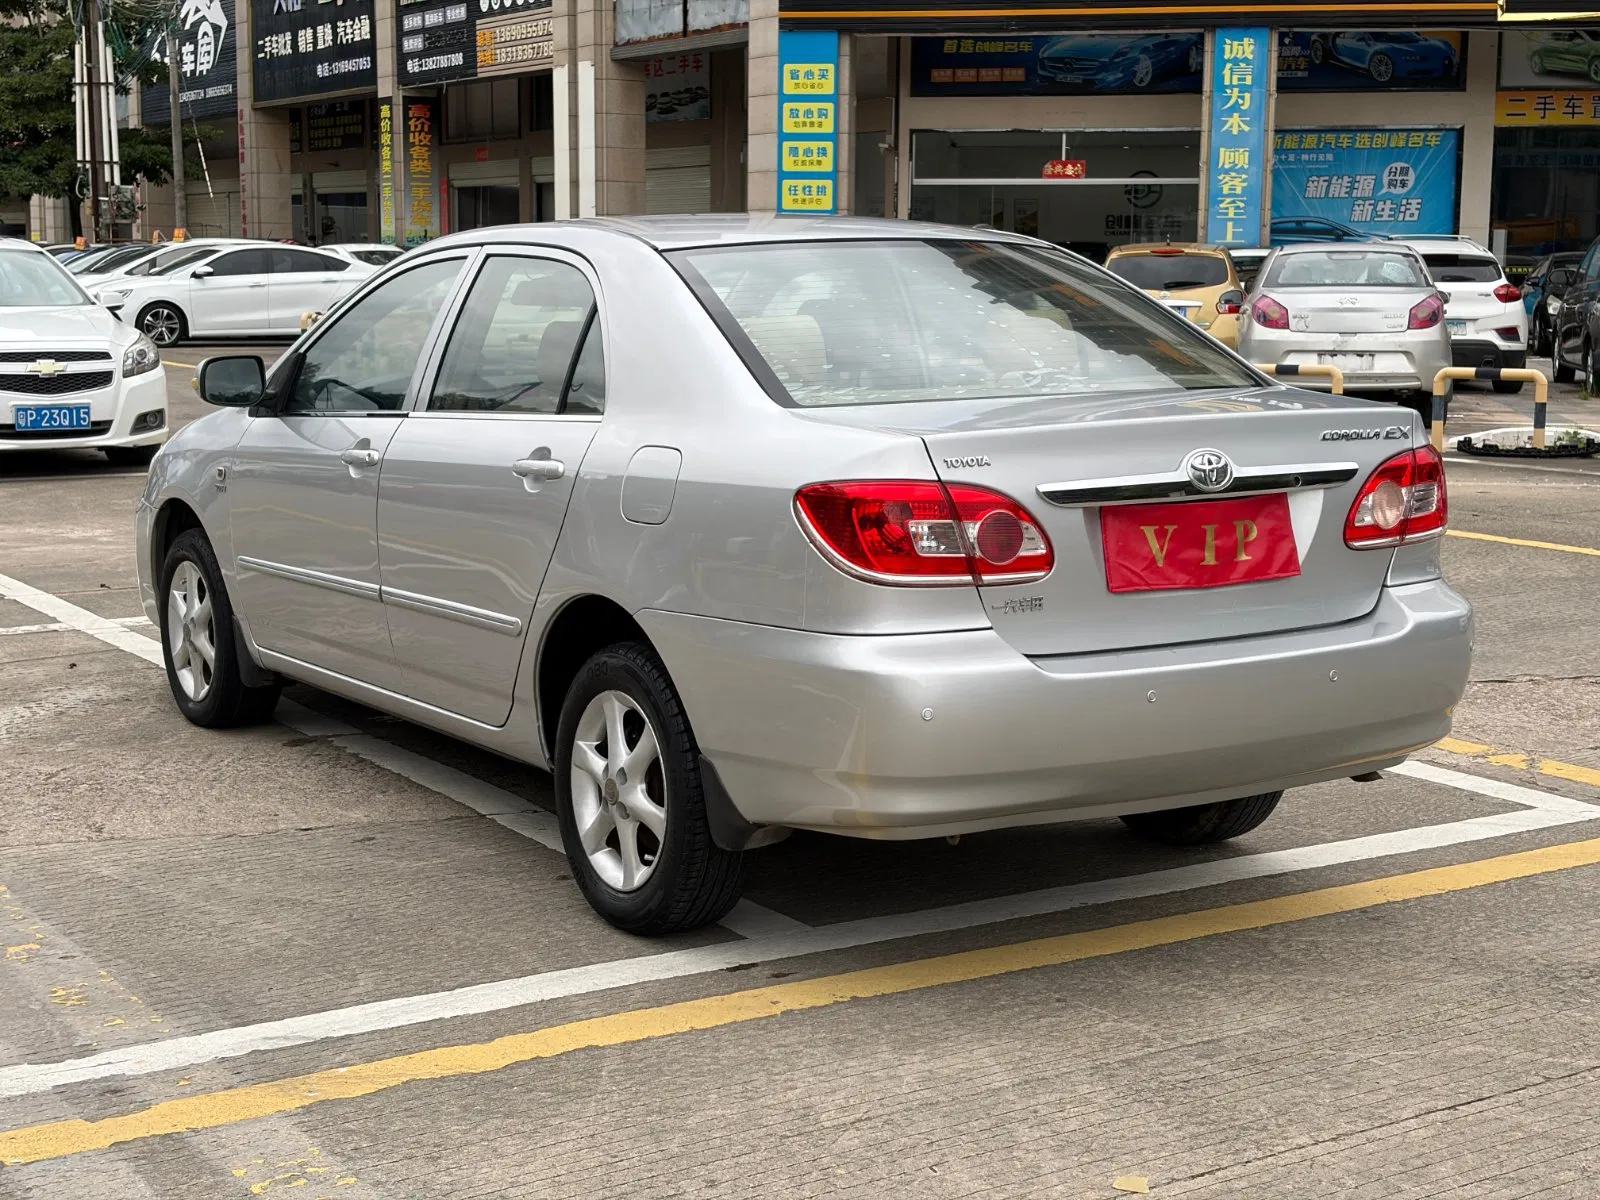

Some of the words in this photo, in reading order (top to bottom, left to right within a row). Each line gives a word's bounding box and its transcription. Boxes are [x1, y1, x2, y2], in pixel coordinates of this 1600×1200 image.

[258, 32, 292, 59] 二手车批发
[298, 27, 313, 53] 销售
[317, 23, 333, 49] 置换
[337, 15, 370, 44] 汽车金融
[789, 69, 829, 80] 省心买
[1221, 37, 1255, 135] 诚信为本
[789, 108, 828, 120] 放心购
[788, 147, 828, 158] 随心换
[408, 104, 432, 228] 高价收各类二手货车
[1387, 166, 1410, 177] 分期
[788, 185, 827, 196] 任性挑
[1305, 175, 1377, 198] 新能源
[1387, 178, 1409, 189] 购车
[1216, 147, 1250, 243] 顾客至上
[1350, 199, 1422, 222] 新生活
[1320, 428, 1381, 441] COROLLA
[1383, 426, 1410, 440] EX
[943, 455, 991, 469] TOYOTA
[1139, 519, 1258, 568] VIP
